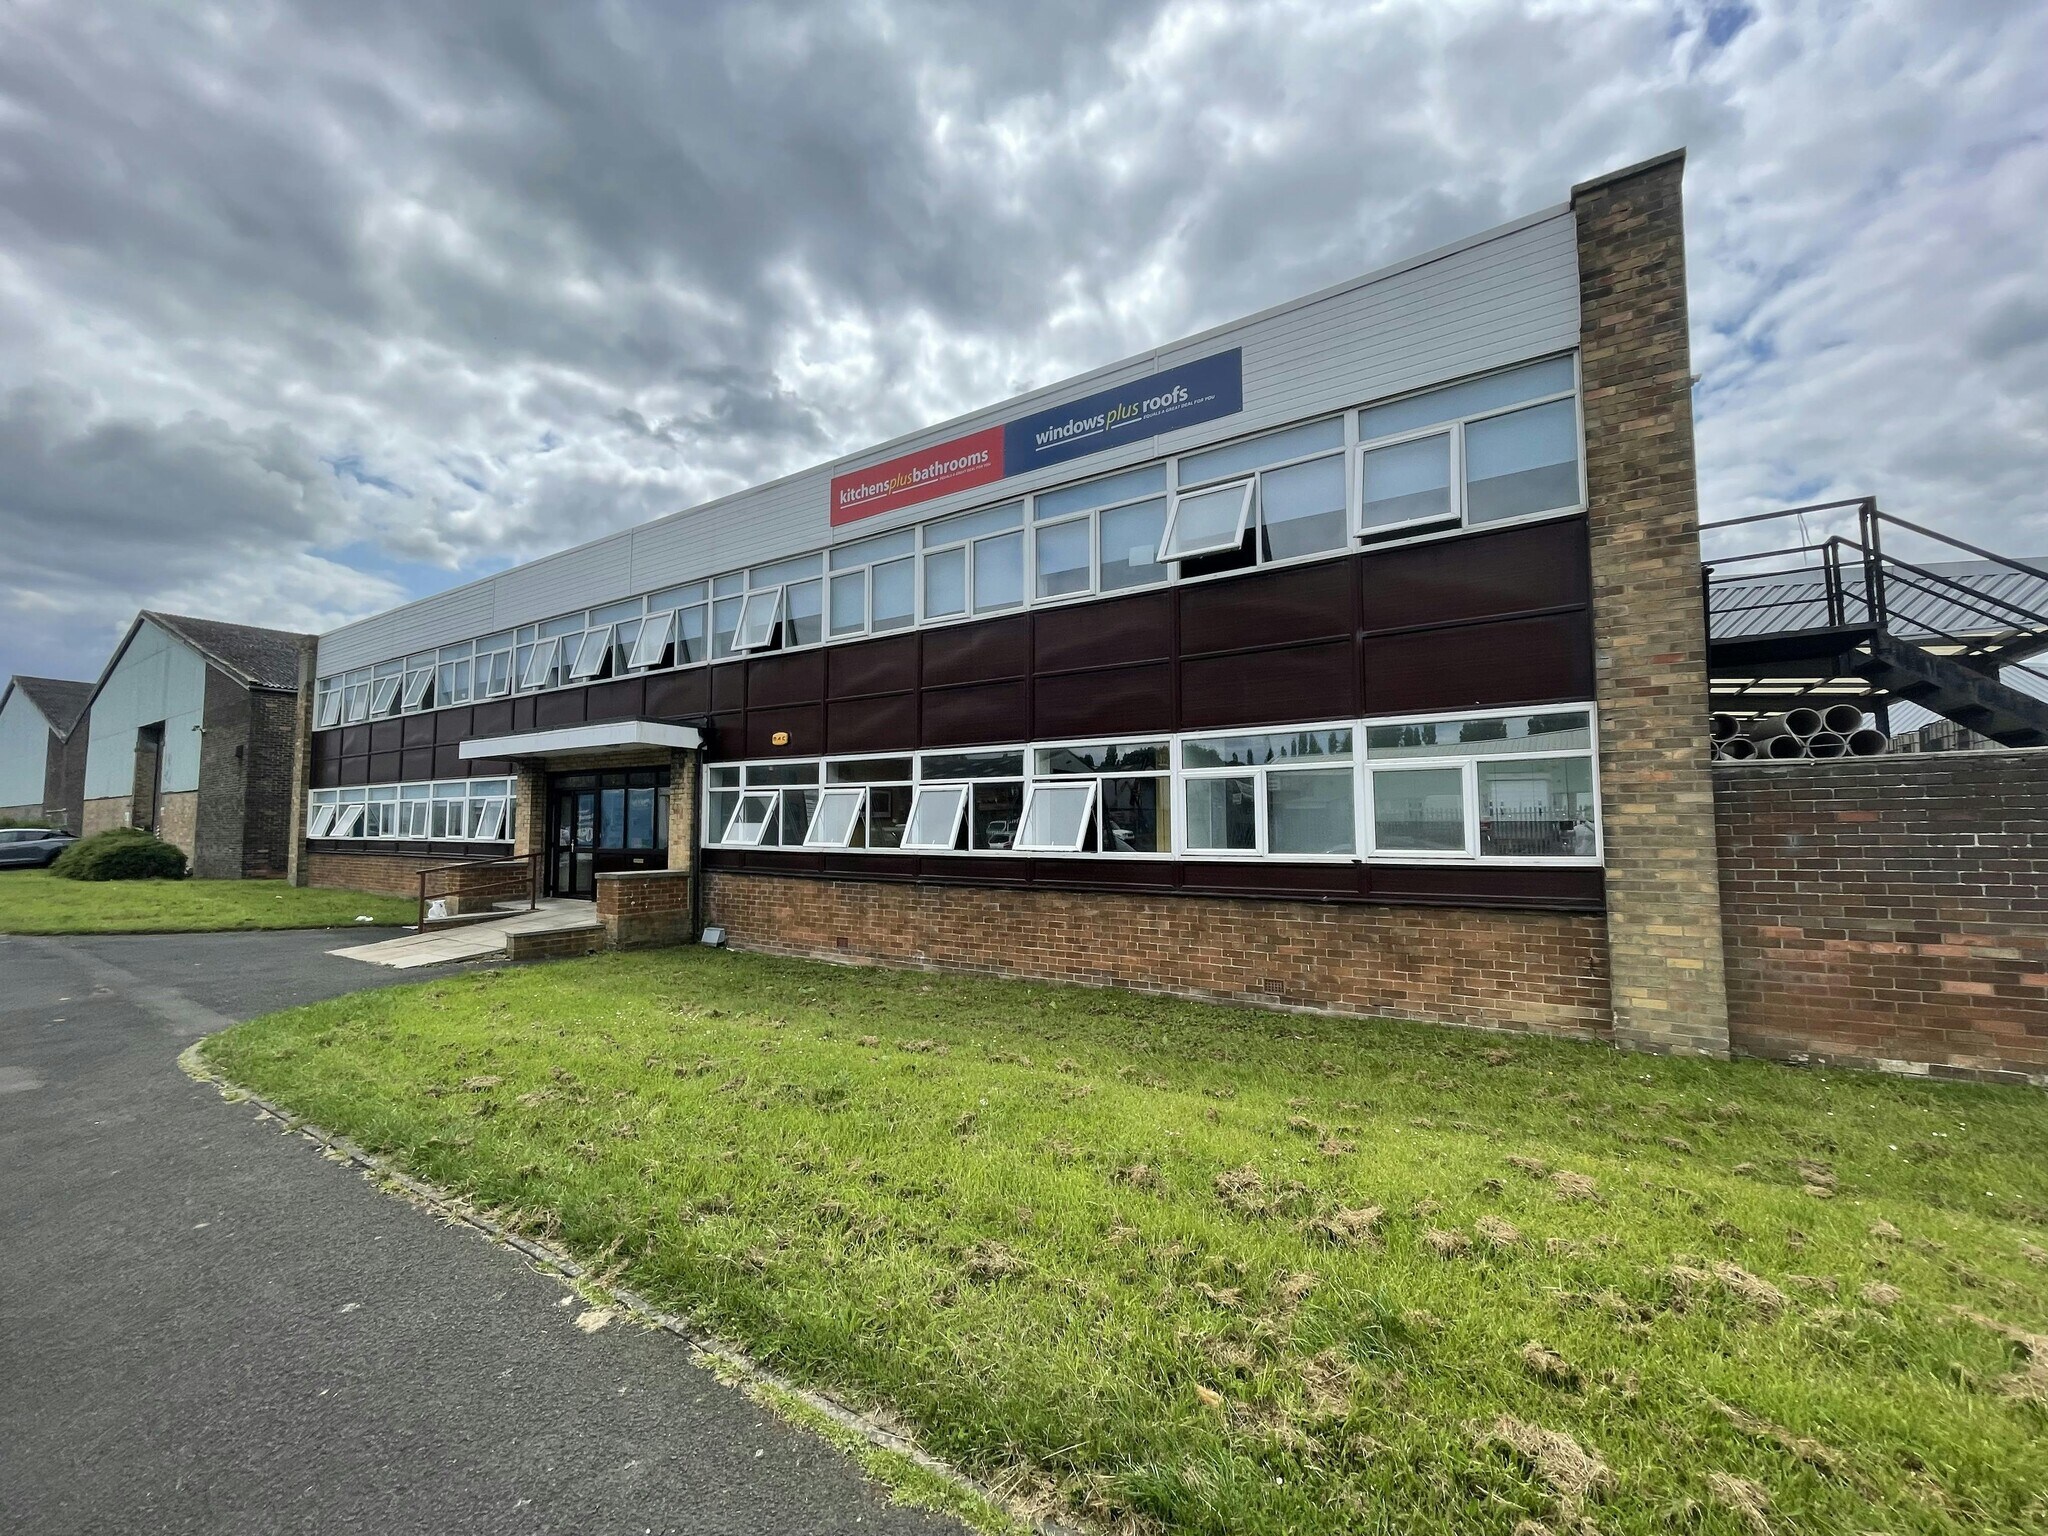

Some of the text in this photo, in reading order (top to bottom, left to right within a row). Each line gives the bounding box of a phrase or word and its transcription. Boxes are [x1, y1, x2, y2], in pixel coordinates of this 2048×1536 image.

[1036, 385, 1189, 445] windows plus roofs
[1165, 405, 1180, 413] GREAT
